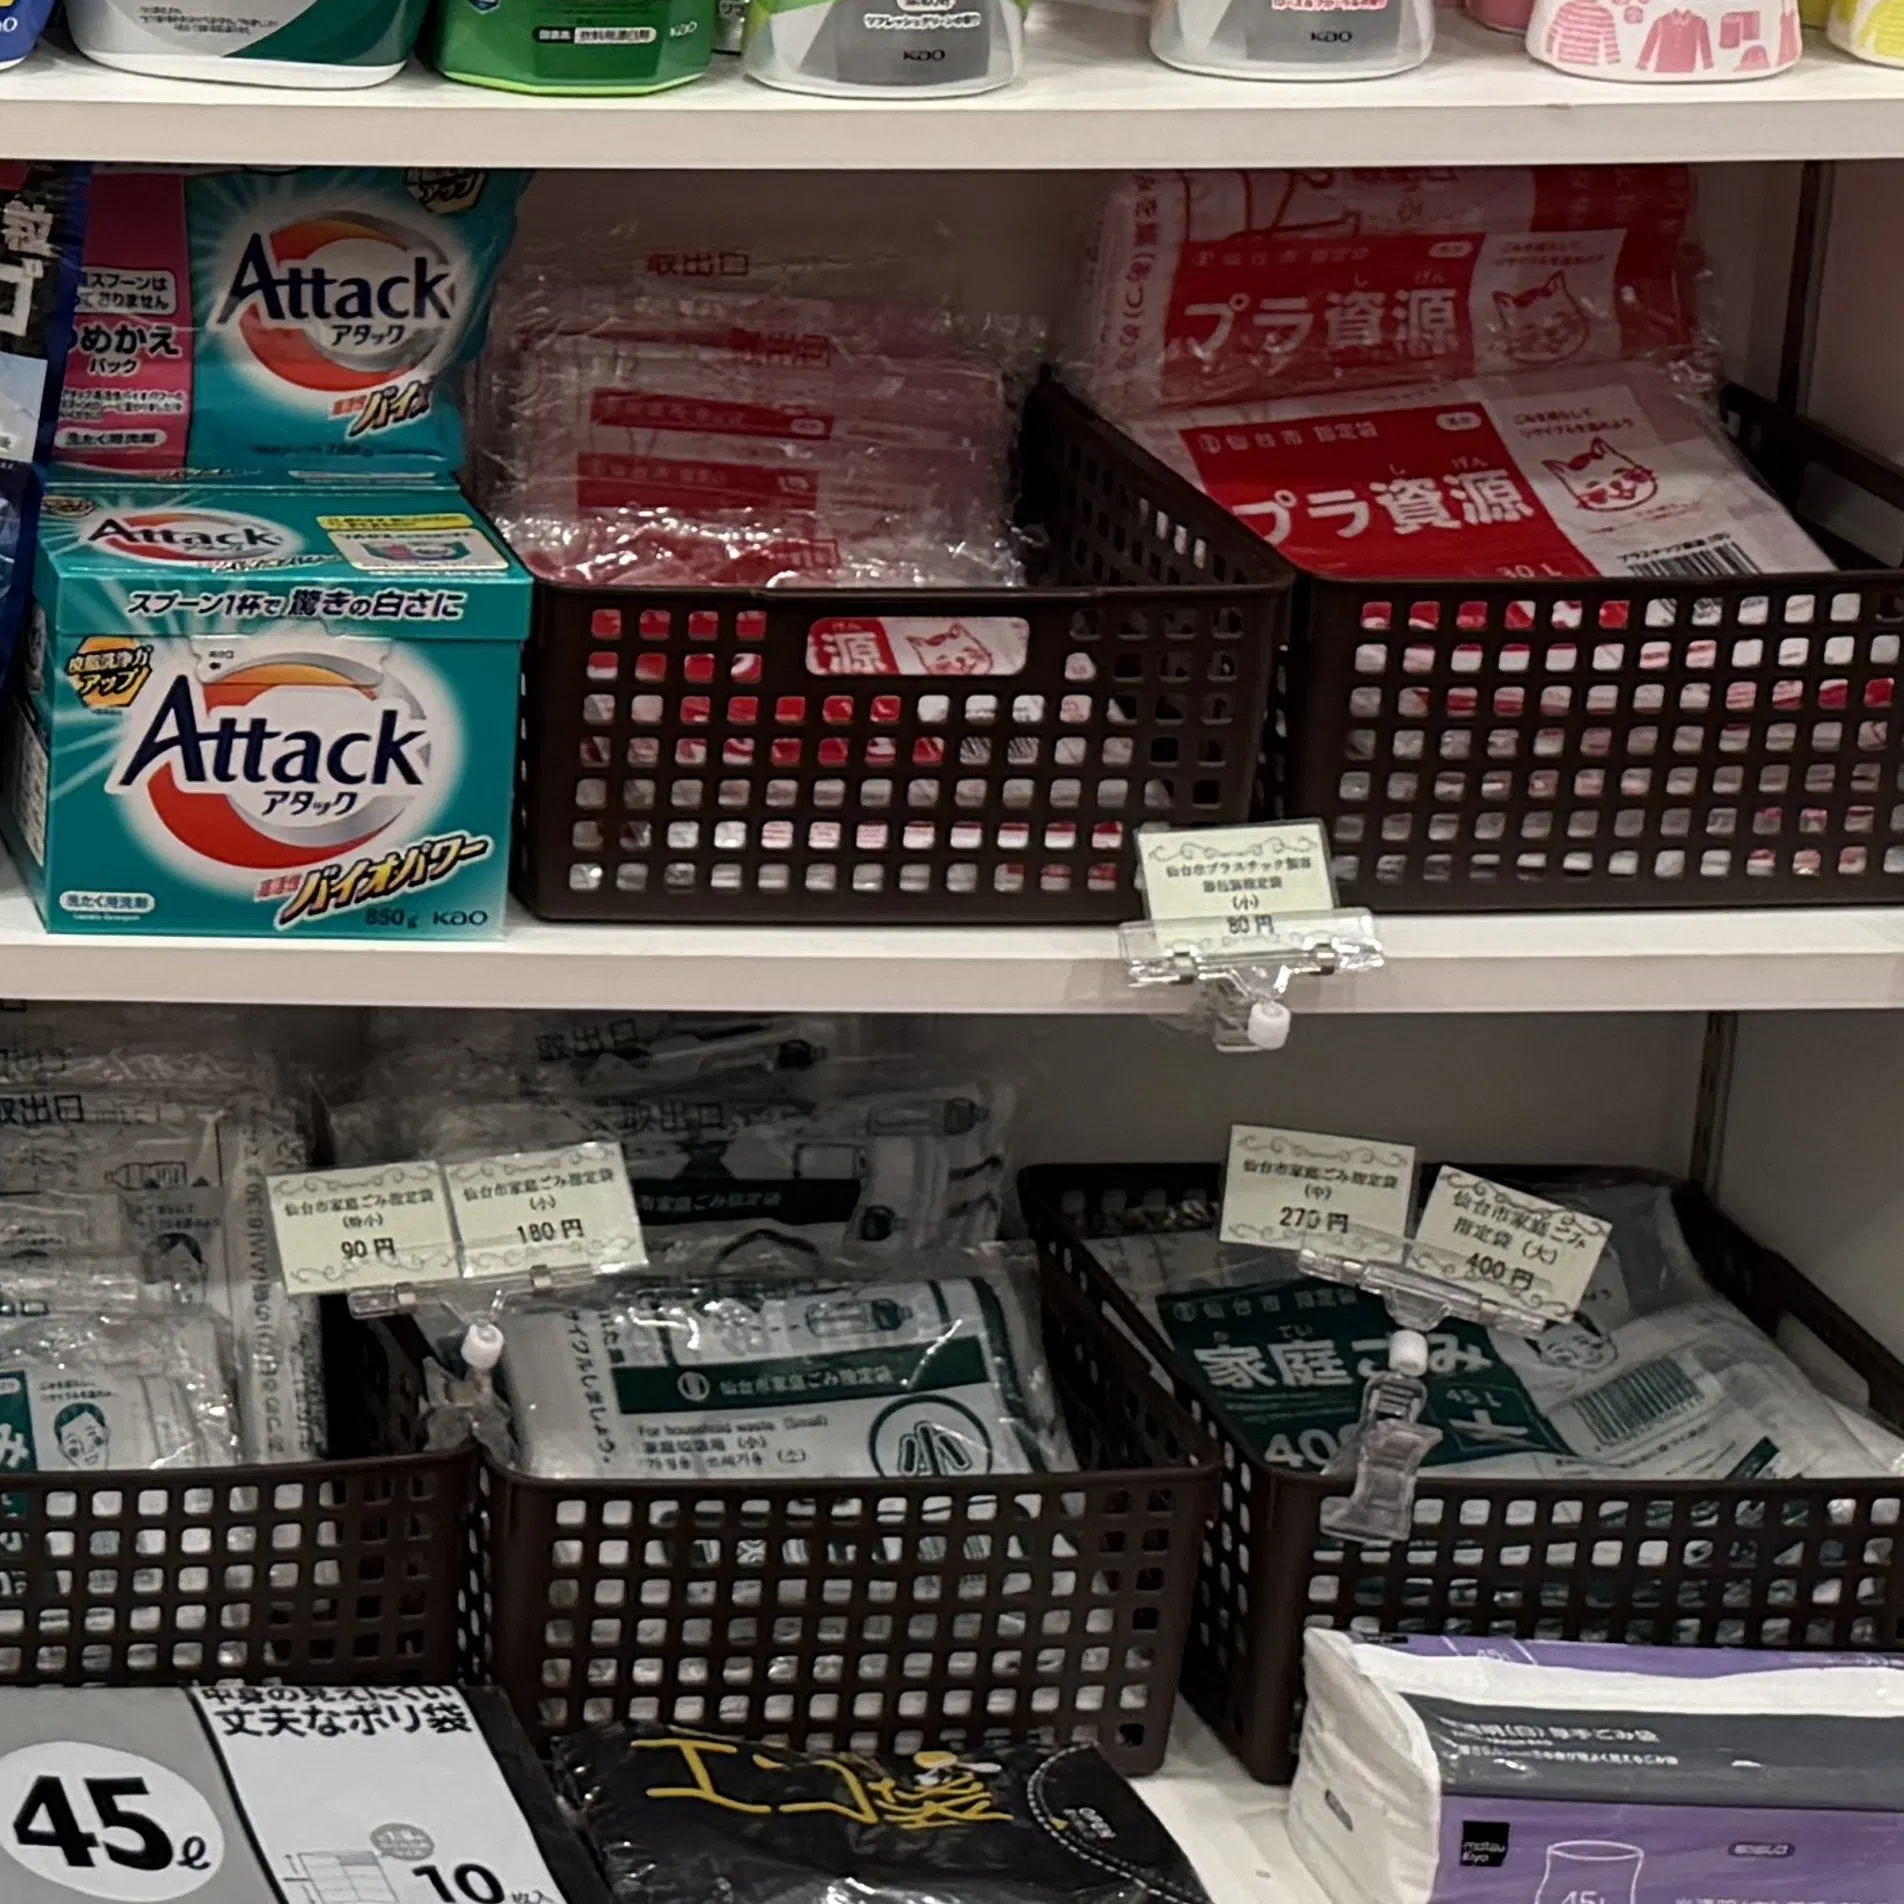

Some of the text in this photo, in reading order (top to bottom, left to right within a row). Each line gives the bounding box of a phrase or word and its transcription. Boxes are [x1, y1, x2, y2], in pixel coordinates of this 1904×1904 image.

[218, 233, 455, 325] Attack
[110, 676, 430, 793] Attack
[262, 790, 358, 817] アタック
